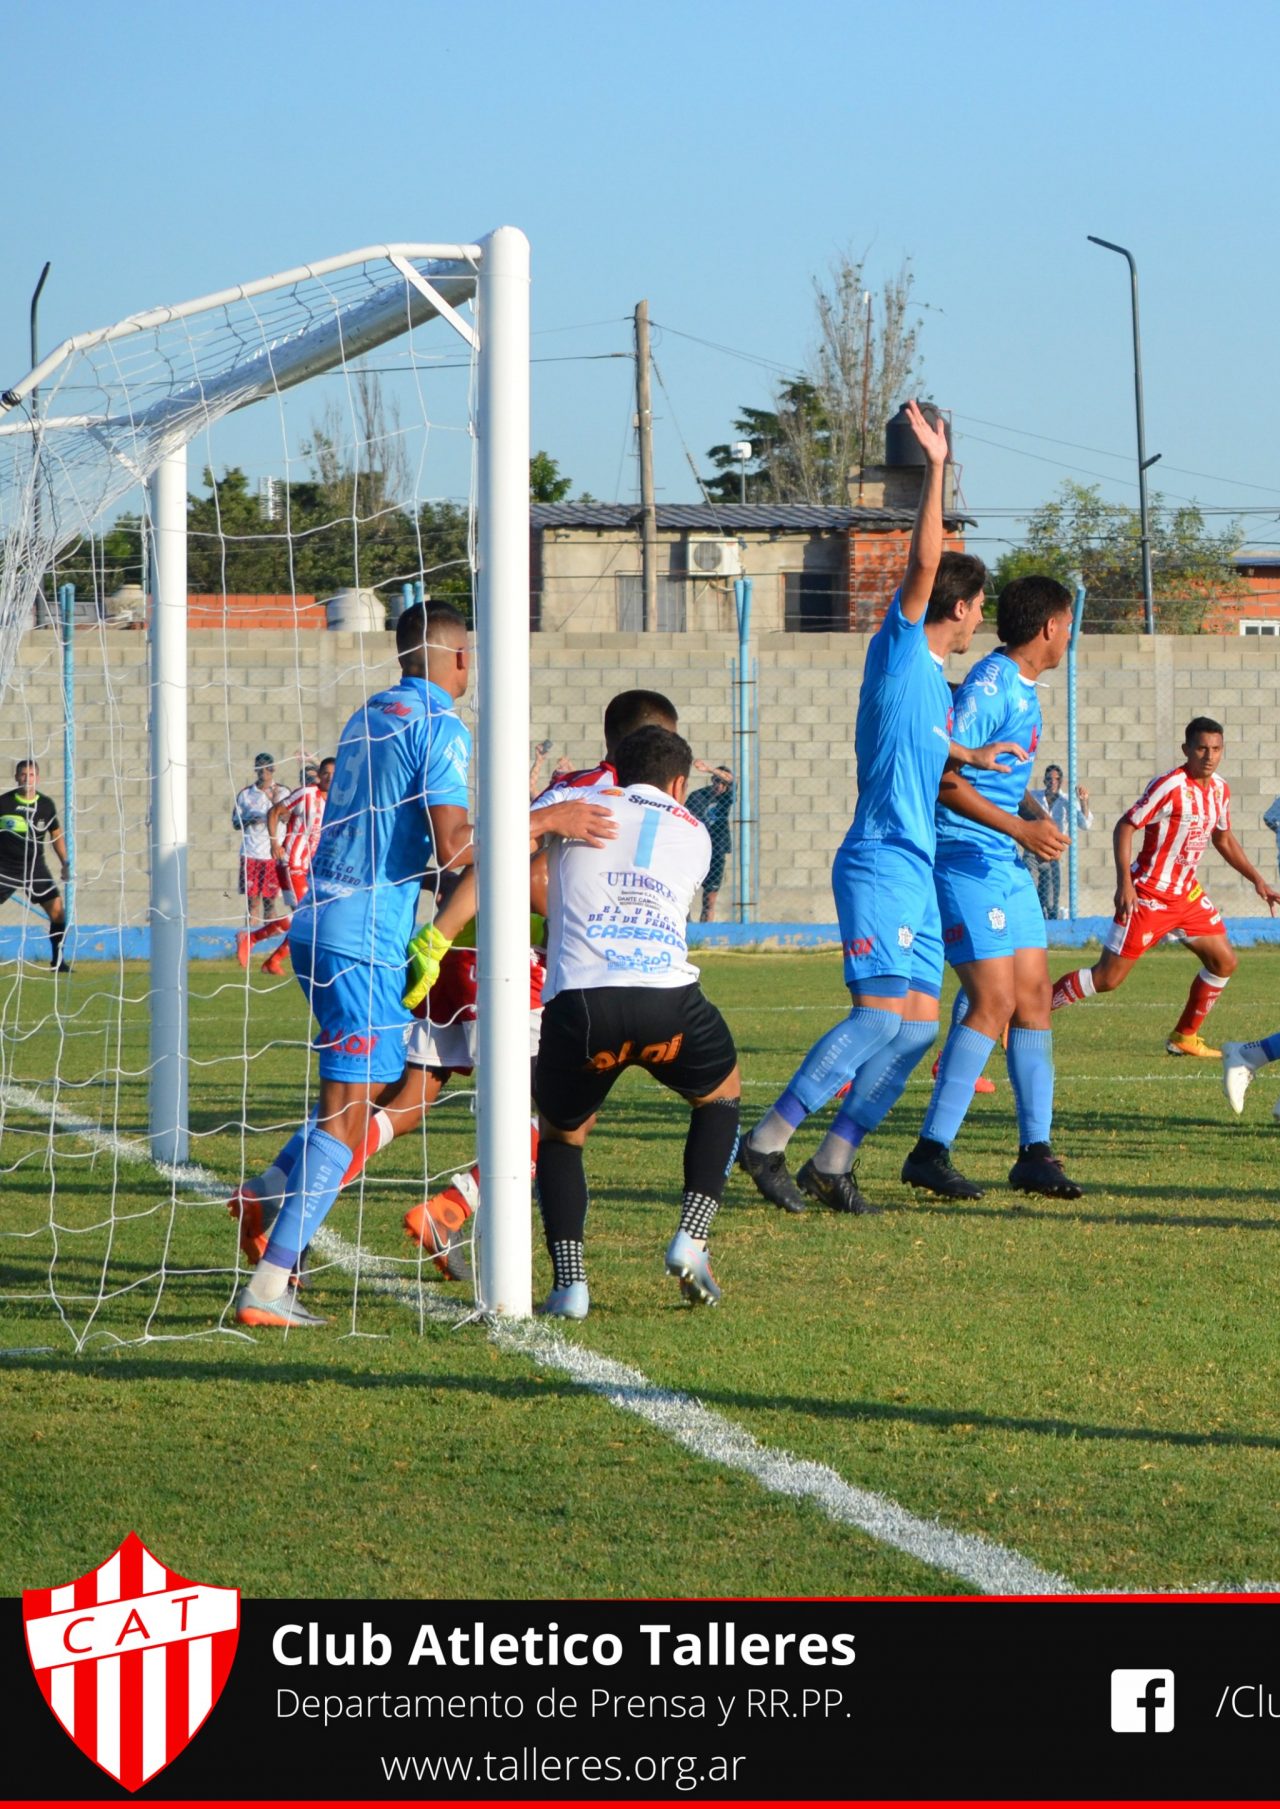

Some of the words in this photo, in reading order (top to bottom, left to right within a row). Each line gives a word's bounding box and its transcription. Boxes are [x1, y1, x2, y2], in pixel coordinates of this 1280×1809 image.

[628, 794, 699, 828] SportClub
[633, 807, 662, 870] 1
[587, 913, 604, 922] DE
[622, 915, 638, 925] DE
[602, 905, 621, 914] EL
[586, 924, 685, 952] CASEROS
[303, 1163, 333, 1219] URQUIZA
